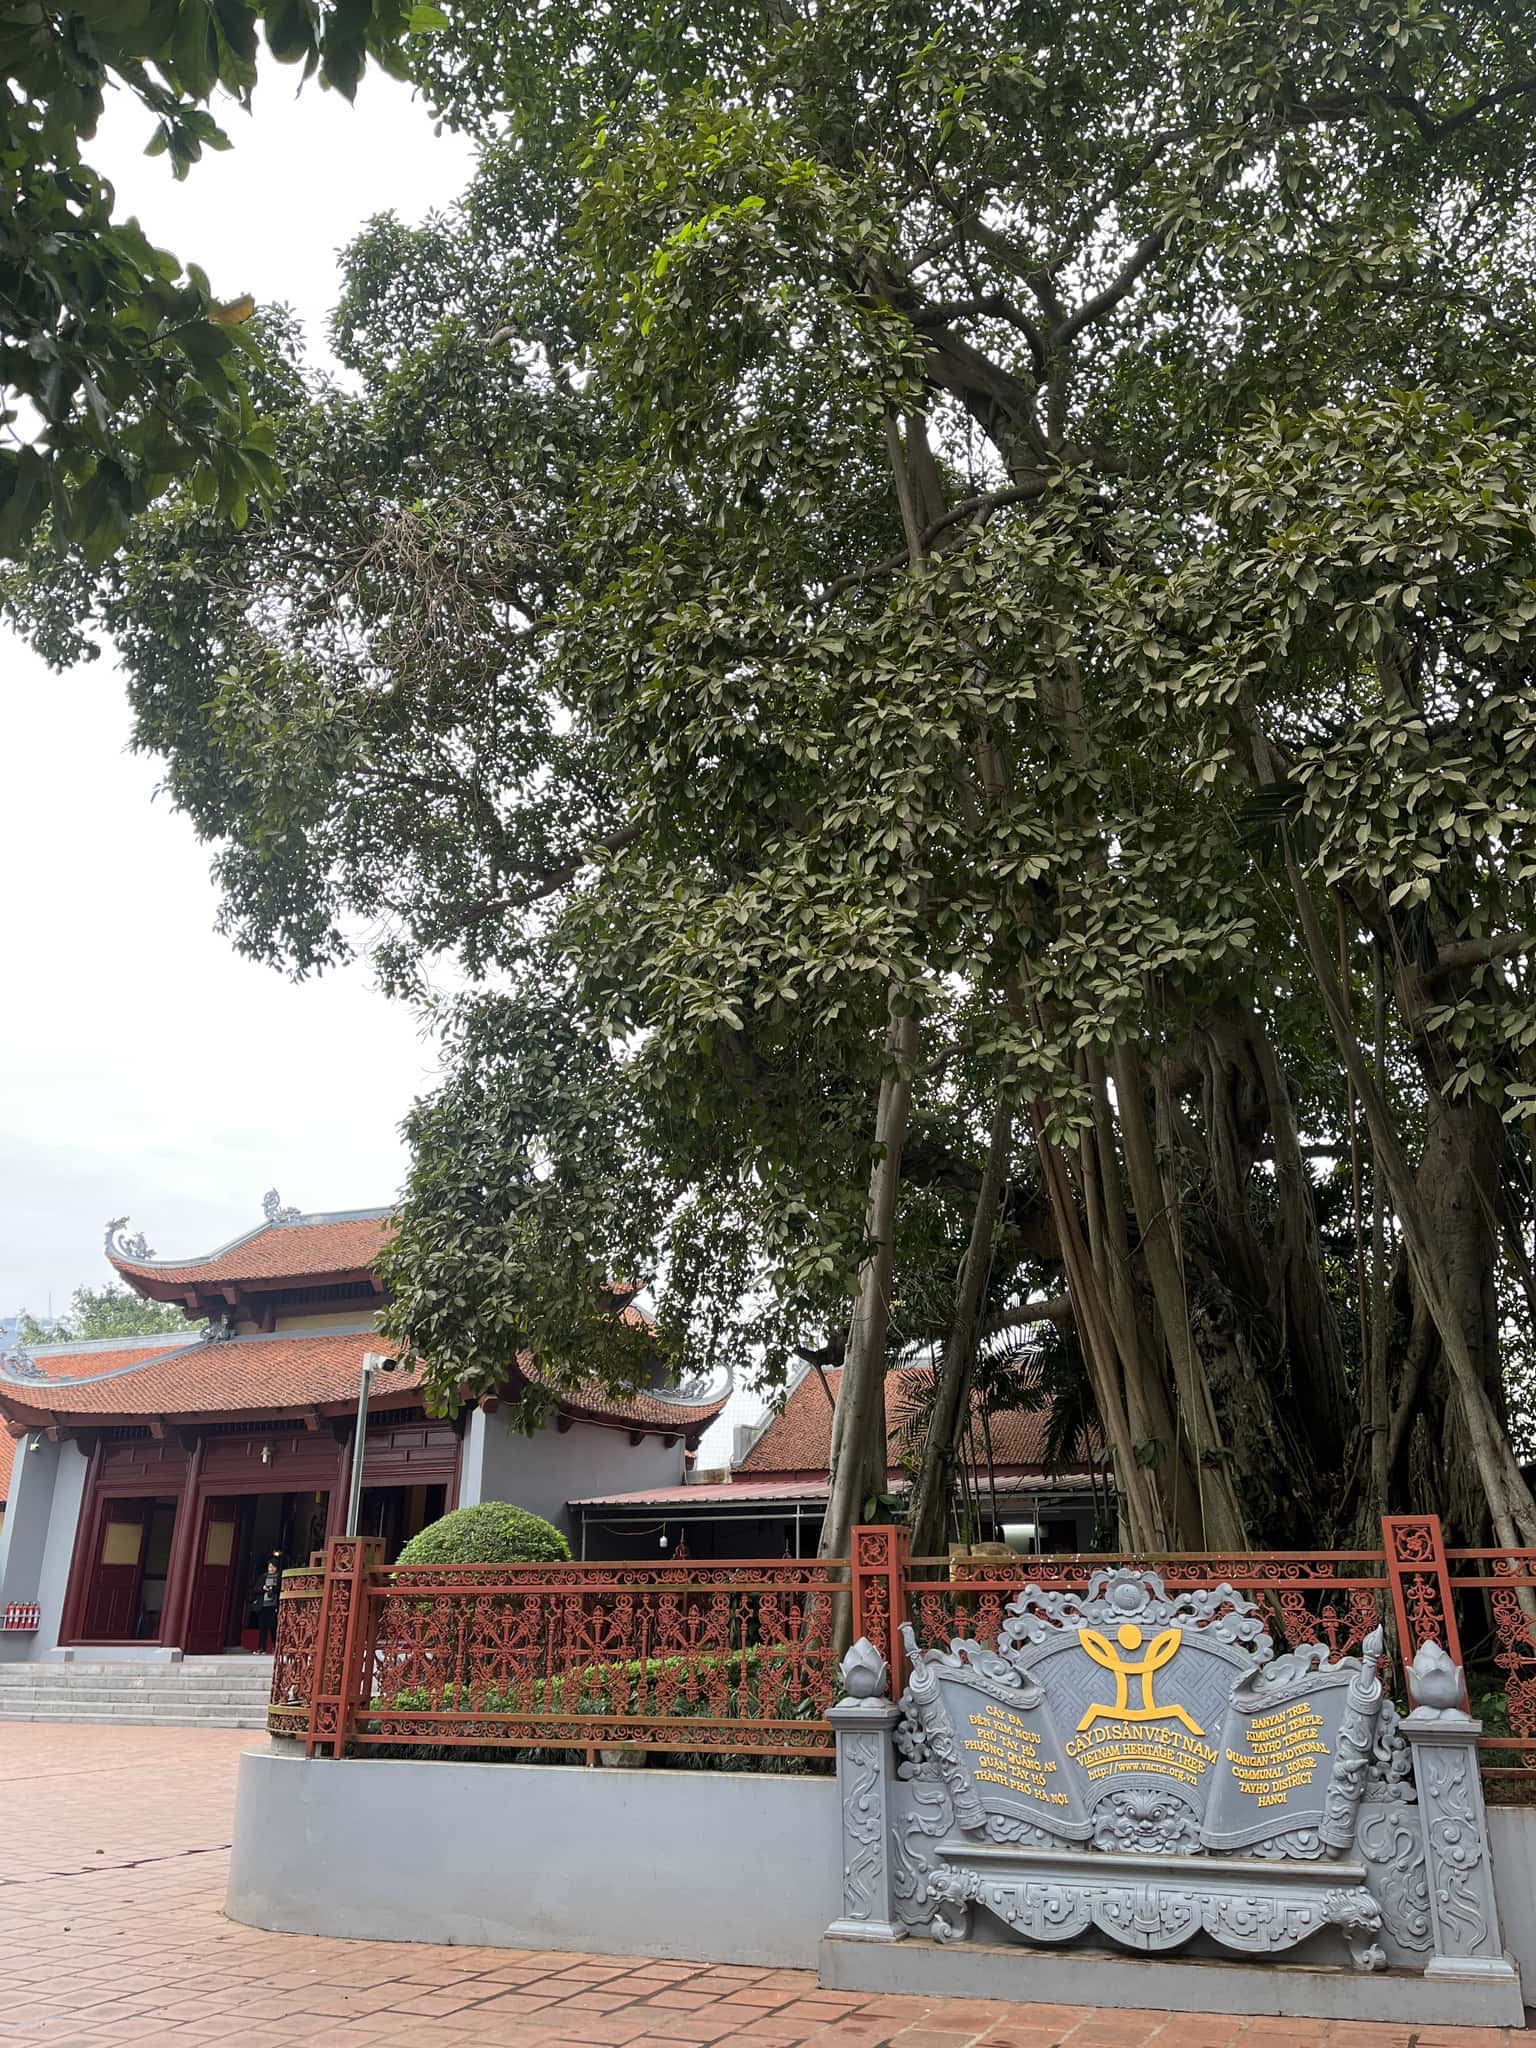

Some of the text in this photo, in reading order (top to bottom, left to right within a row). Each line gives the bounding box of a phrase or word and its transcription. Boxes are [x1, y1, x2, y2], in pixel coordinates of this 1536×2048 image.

[1251, 1702, 1311, 1729] BANYAN TREE
[1288, 1715, 1324, 1731] TEMPLE
[993, 1720, 1013, 1736] KIM
[1251, 1728, 1319, 1754] TAYHO TEMPLE
[1076, 1743, 1207, 1774] VIETNAM HERITAGE TREE
[1225, 1742, 1331, 1767] QUANGAN TRADITIONAL
[1044, 1761, 1057, 1773] AN
[1232, 1757, 1317, 1780] COMMUNAL HOUSE
[1238, 1771, 1313, 1794] TAYHO DISTRICT
[1258, 1792, 1288, 1807] HANOI
